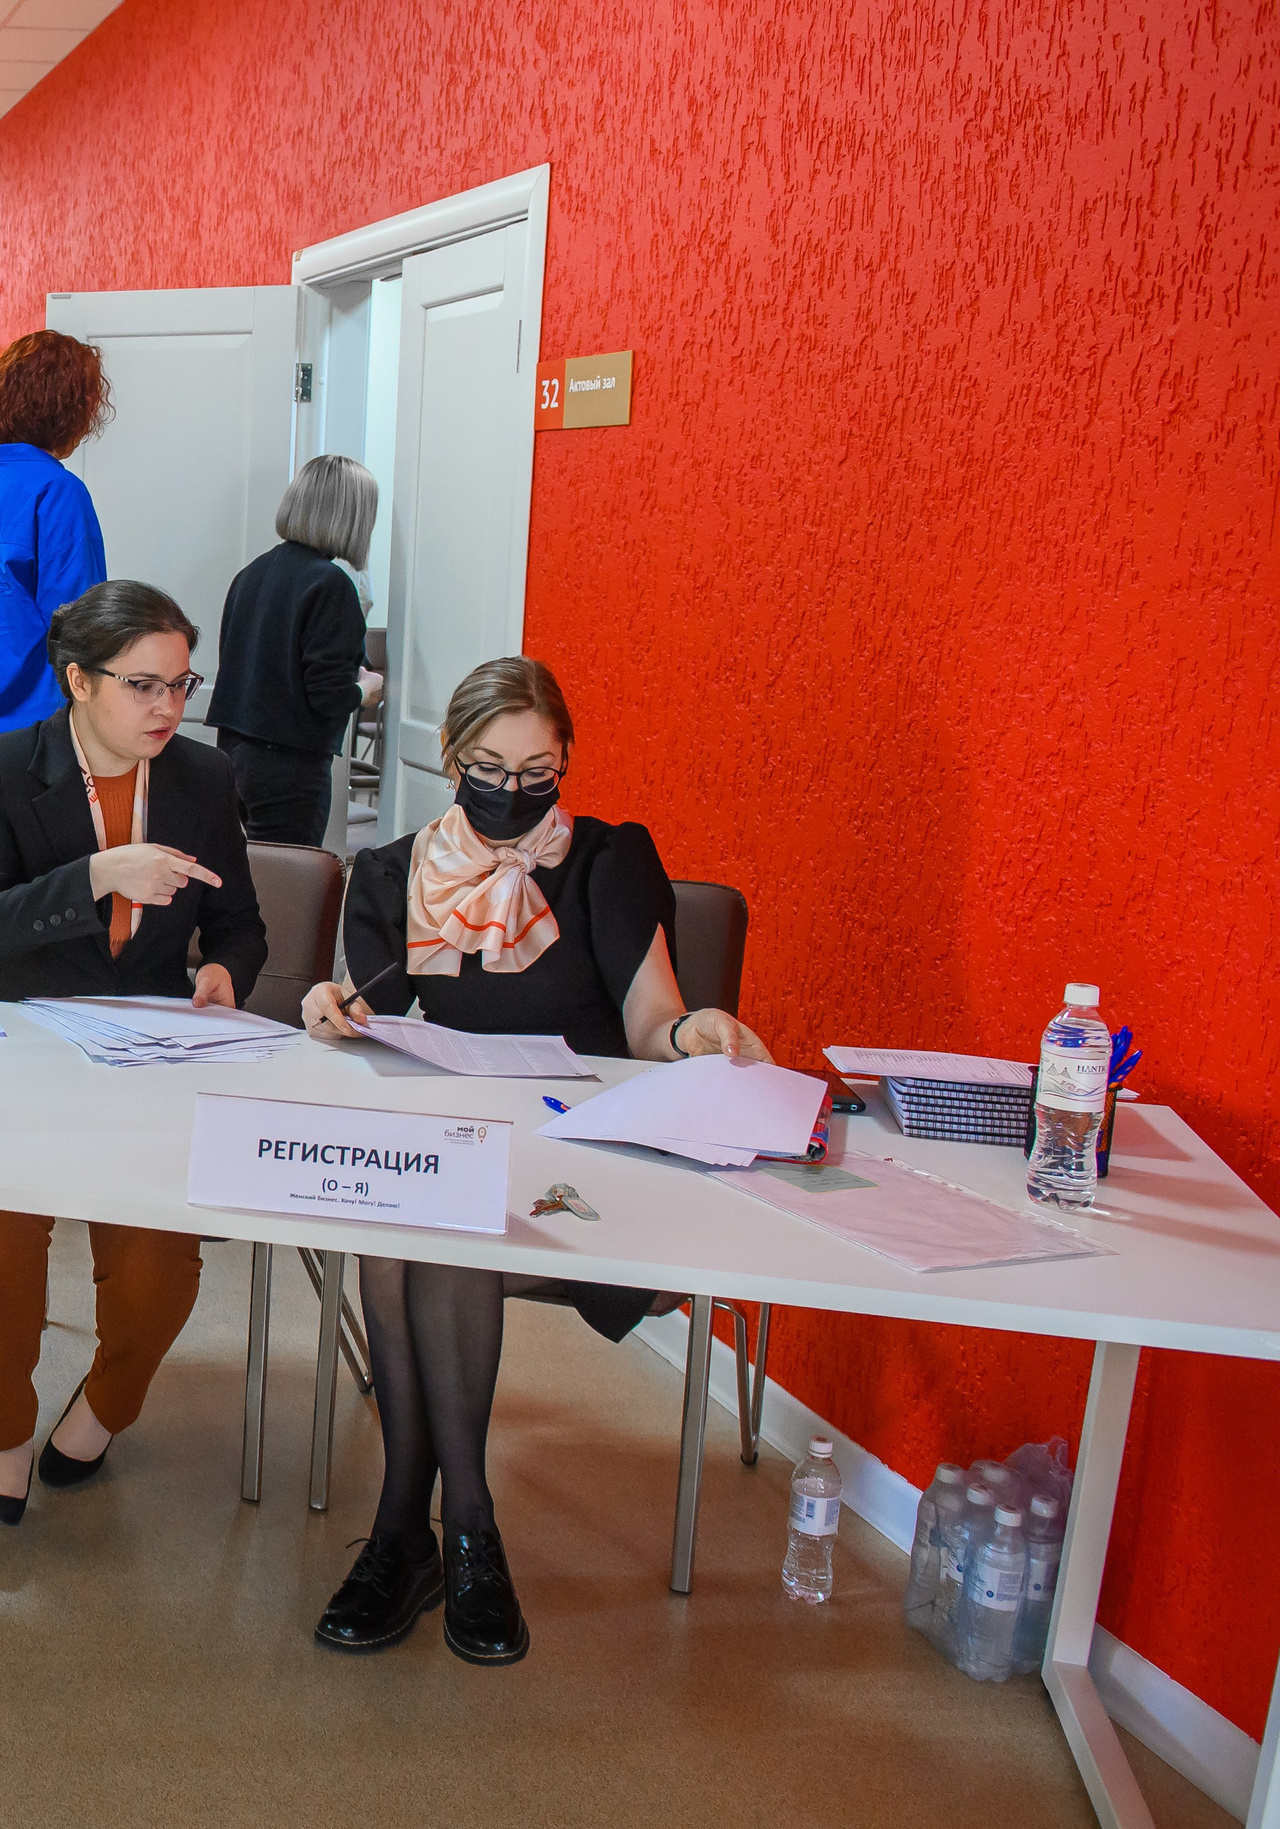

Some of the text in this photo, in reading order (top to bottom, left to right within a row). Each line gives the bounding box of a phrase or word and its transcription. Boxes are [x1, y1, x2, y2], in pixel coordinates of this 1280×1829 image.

[569, 375, 616, 392] Актовый зал
[541, 378, 560, 410] 32
[444, 1129, 474, 1140] бизнес
[457, 1125, 475, 1133] мой
[258, 1138, 440, 1175] РЕГИСТРАЦИЯ
[321, 1177, 338, 1193] (О
[354, 1180, 370, 1197] Я)
[289, 1192, 316, 1200] Женский
[340, 1197, 357, 1205] Хочу!
[358, 1199, 377, 1207] Могу!
[377, 1201, 401, 1209] Делаю!
